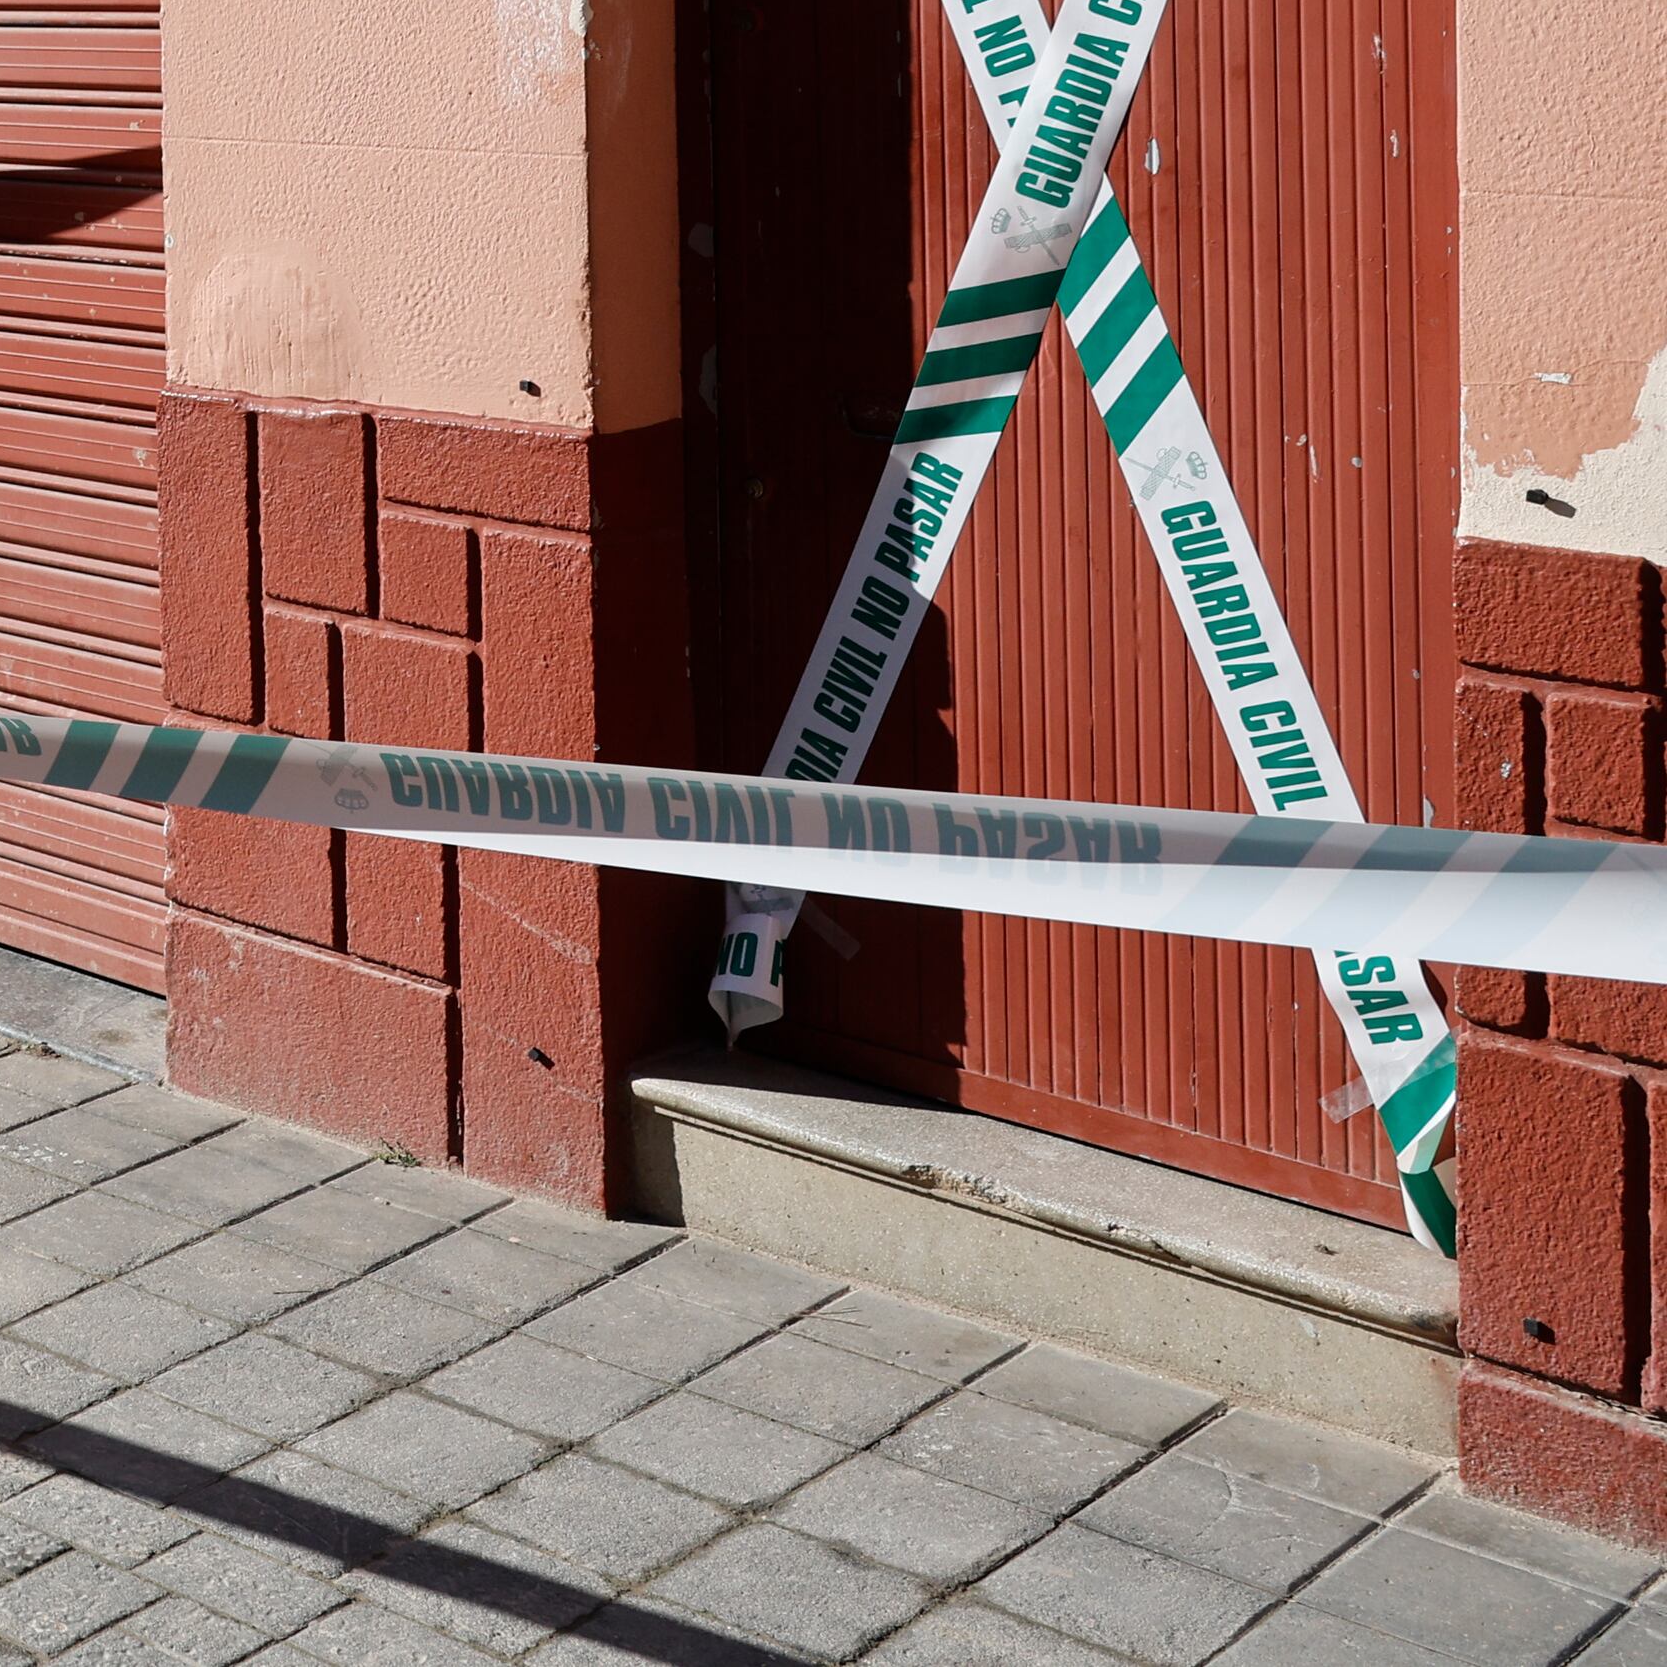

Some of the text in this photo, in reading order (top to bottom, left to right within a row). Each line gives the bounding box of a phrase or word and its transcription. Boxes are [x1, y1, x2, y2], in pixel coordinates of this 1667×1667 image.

[974, 14, 1036, 78] NO
[1015, 32, 1130, 209] GUARDIA
[876, 451, 966, 583] PASAR
[850, 575, 913, 638] NO
[1159, 498, 1331, 812] GUARDIA CIVIL
[812, 625, 889, 725] CIVIL
